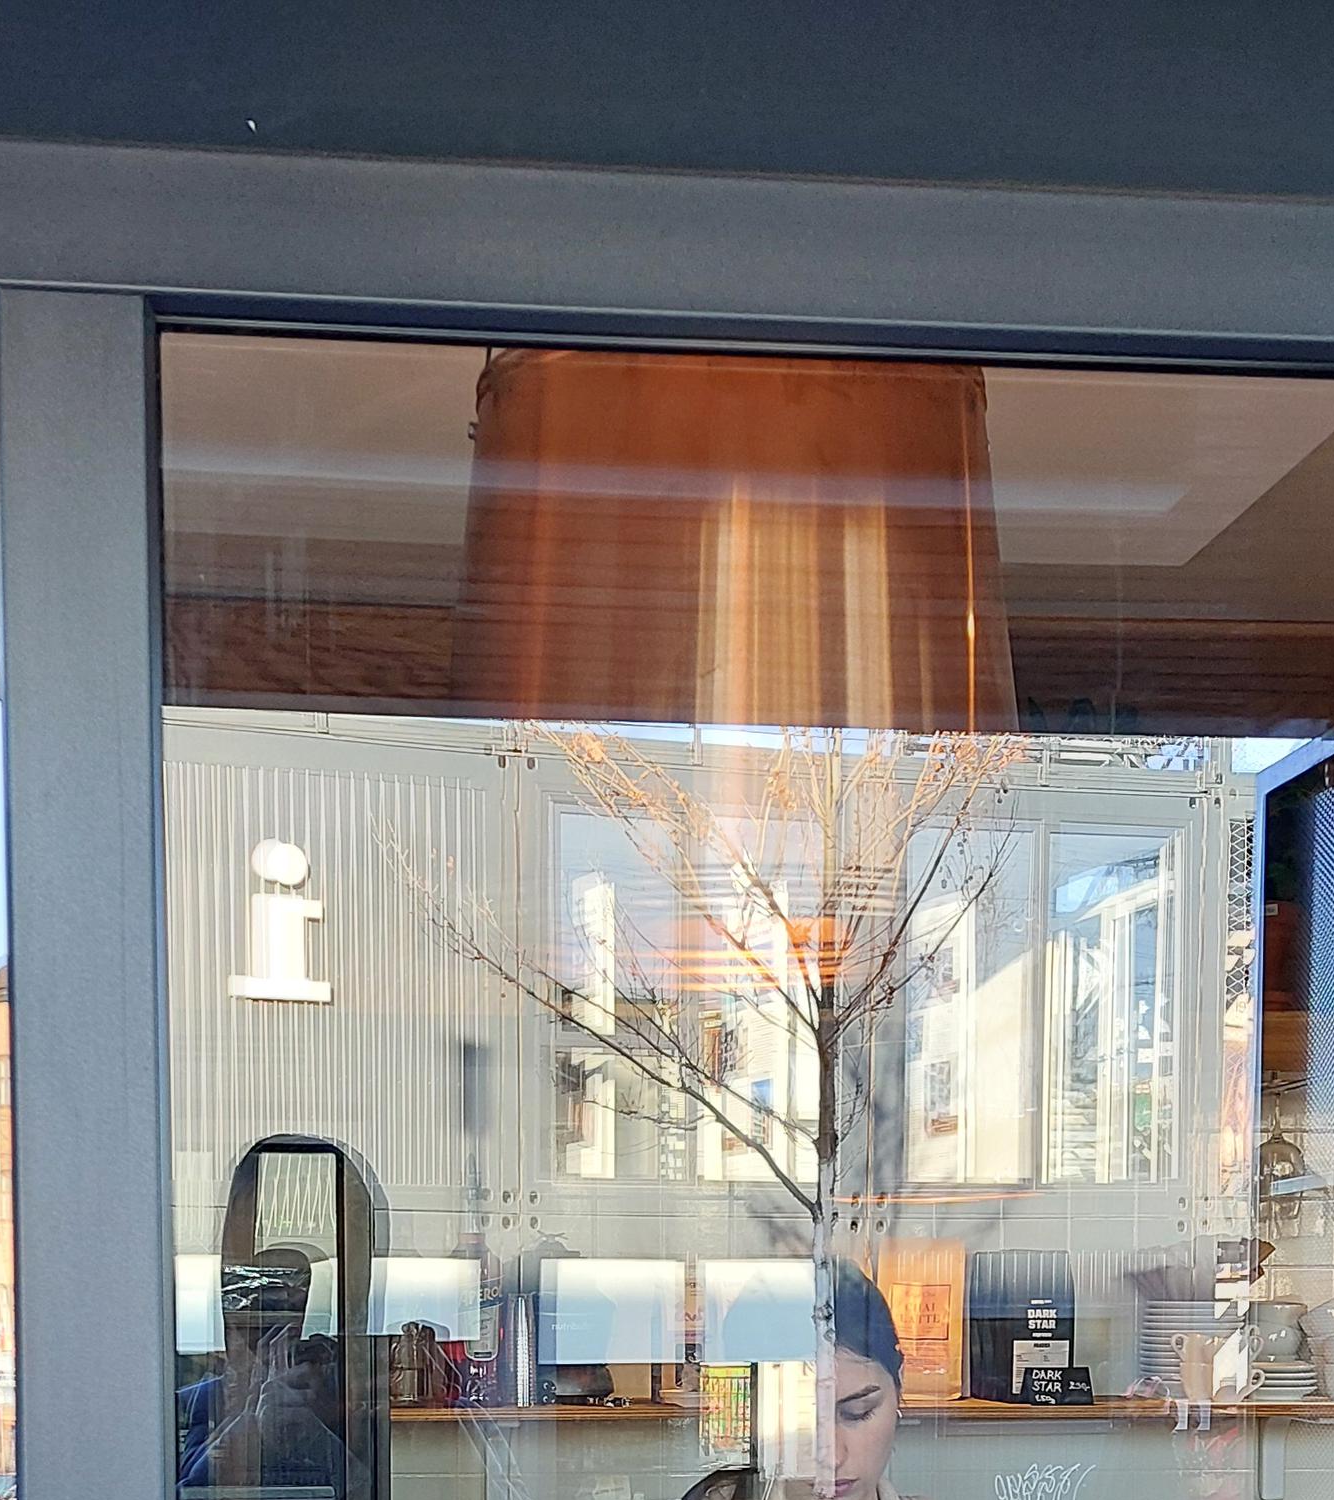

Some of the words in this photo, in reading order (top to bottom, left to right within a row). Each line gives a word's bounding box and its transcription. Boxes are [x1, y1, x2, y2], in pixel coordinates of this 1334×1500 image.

[1027, 1308, 1058, 1319] DARK
[1028, 1319, 1057, 1330] STAR
[1031, 1369, 1063, 1381] DARK
[1031, 1380, 1063, 1393] STAR
